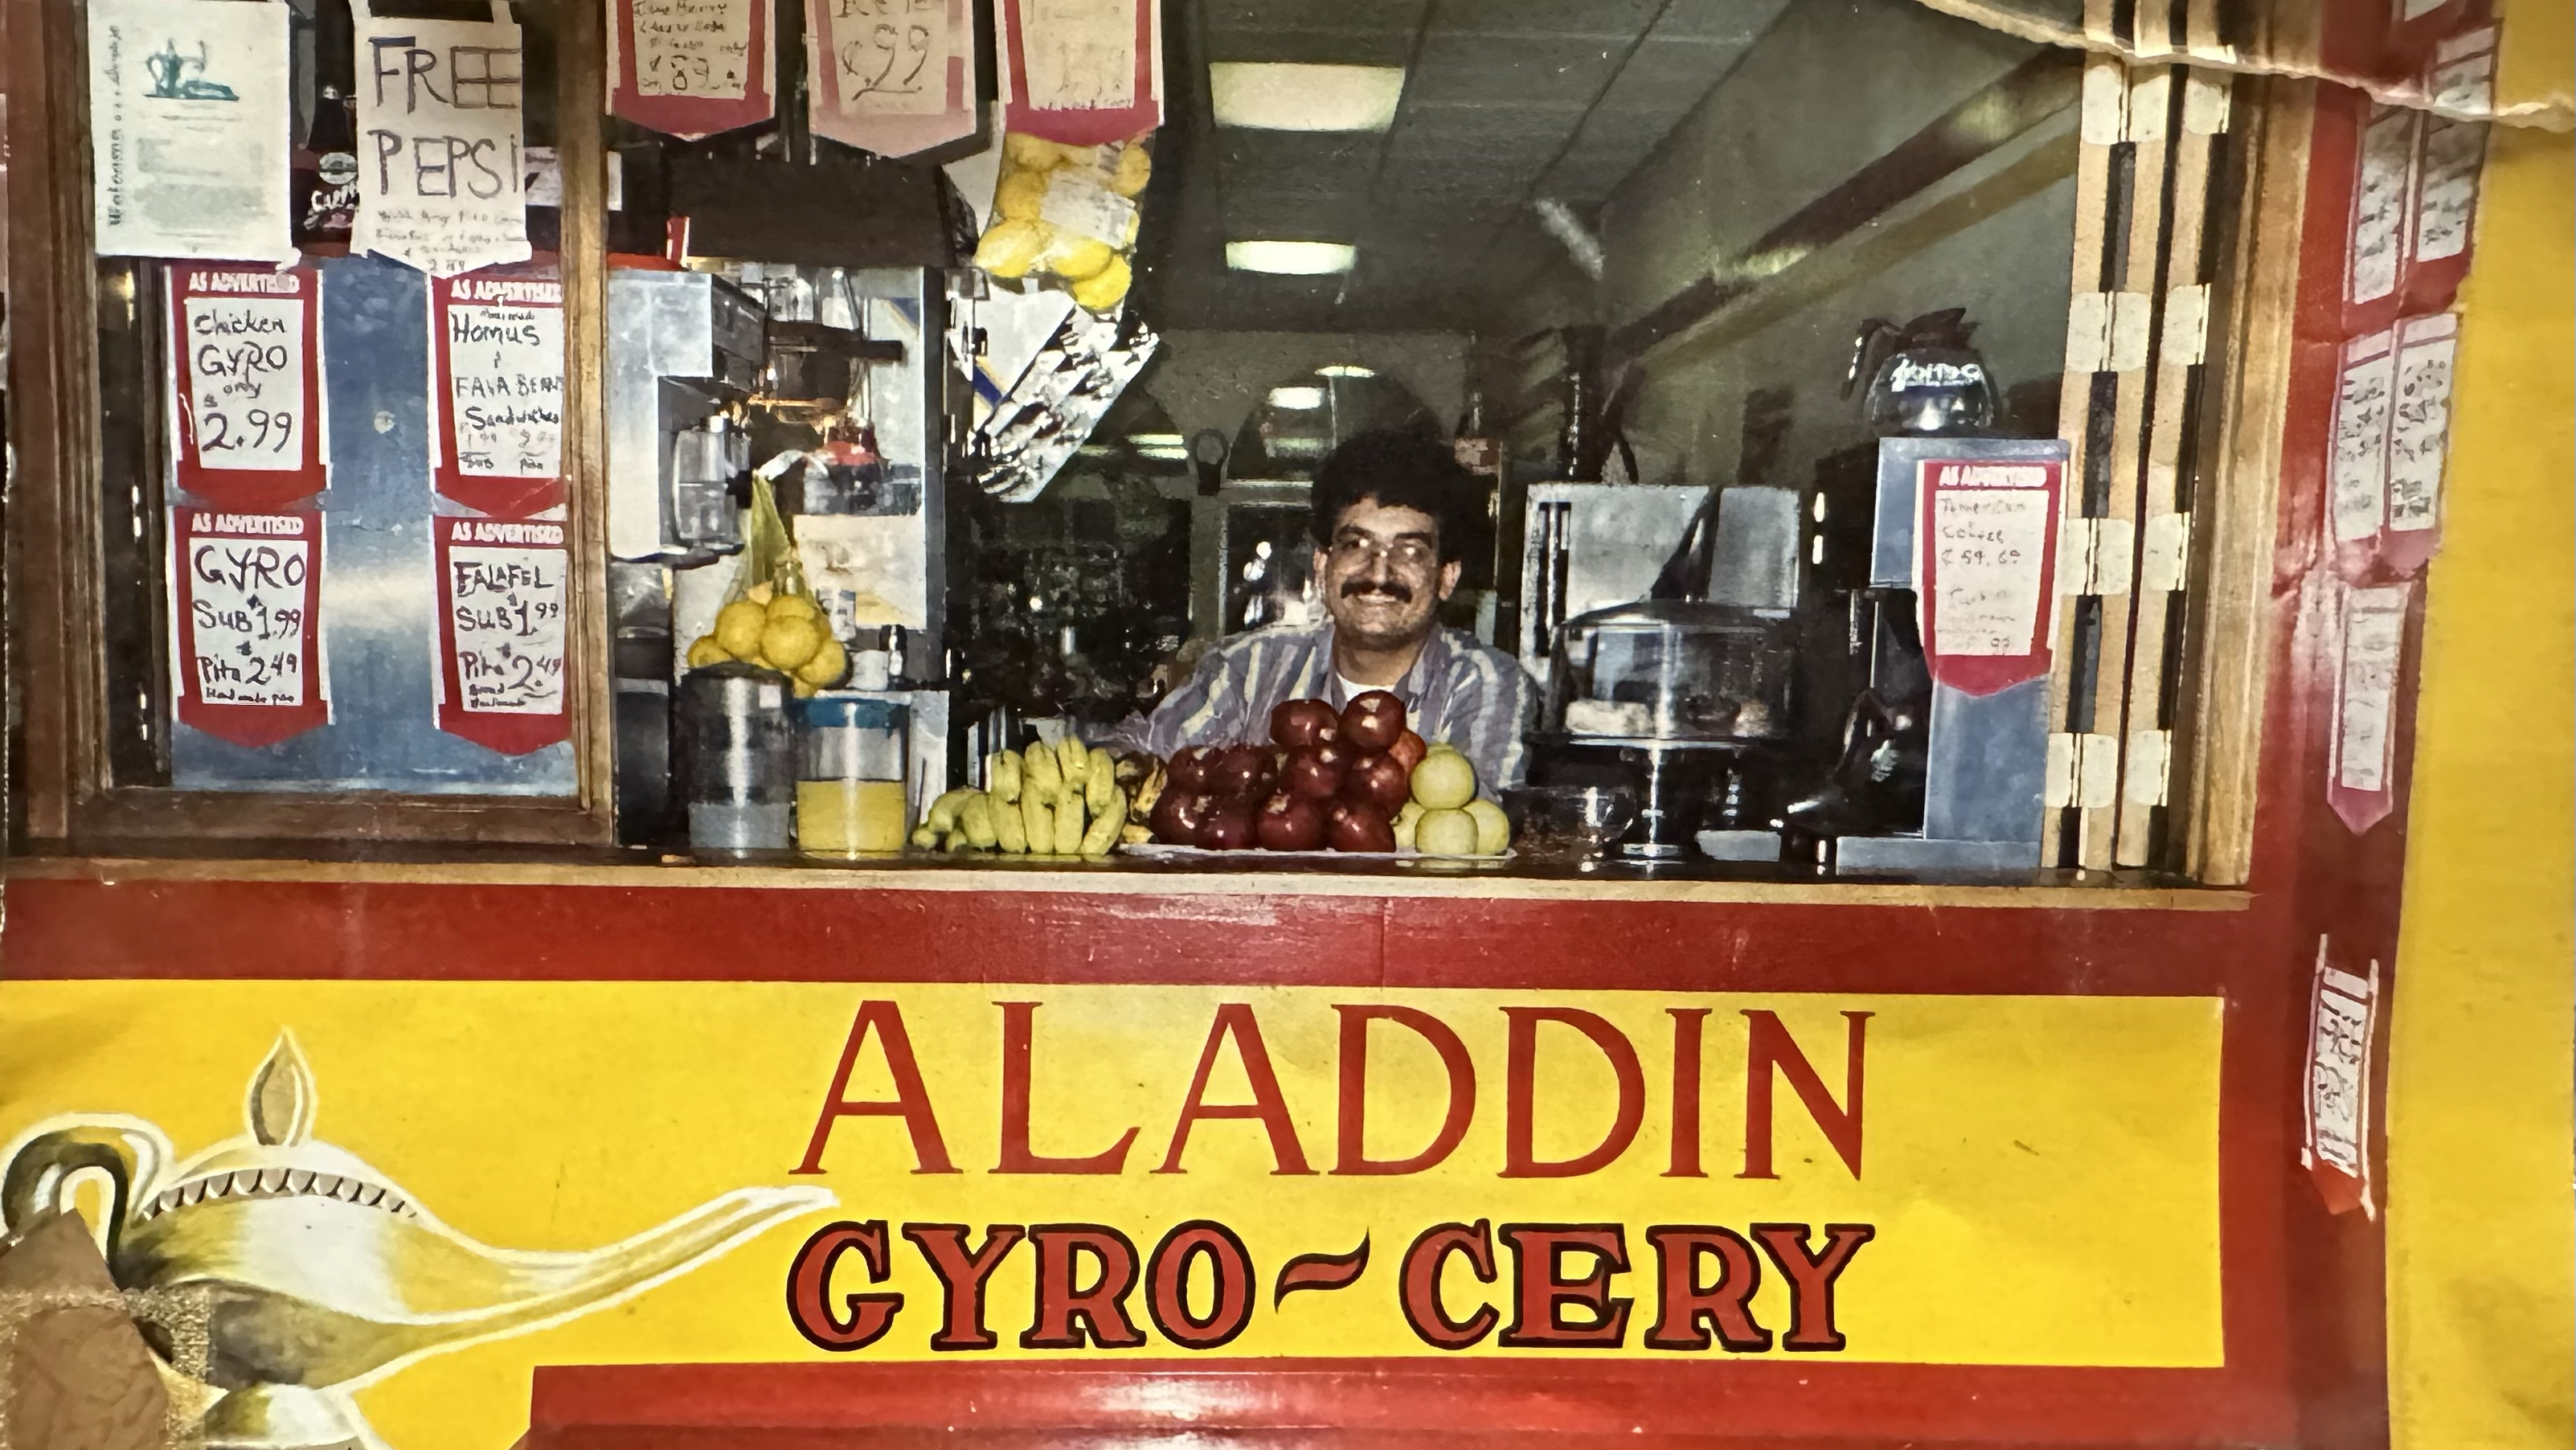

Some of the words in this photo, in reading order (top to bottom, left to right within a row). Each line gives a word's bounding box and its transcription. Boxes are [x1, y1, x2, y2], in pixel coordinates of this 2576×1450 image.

[368, 35, 522, 114] FREE
[189, 272, 207, 292] AS
[450, 279, 472, 300] AS
[191, 513, 211, 532] AS
[215, 514, 305, 535] ADVERTISED
[451, 522, 472, 541] AS
[474, 522, 564, 545] ADVERTISED
[195, 545, 305, 593] GYRO
[788, 999, 1876, 1182] ALADDIN
